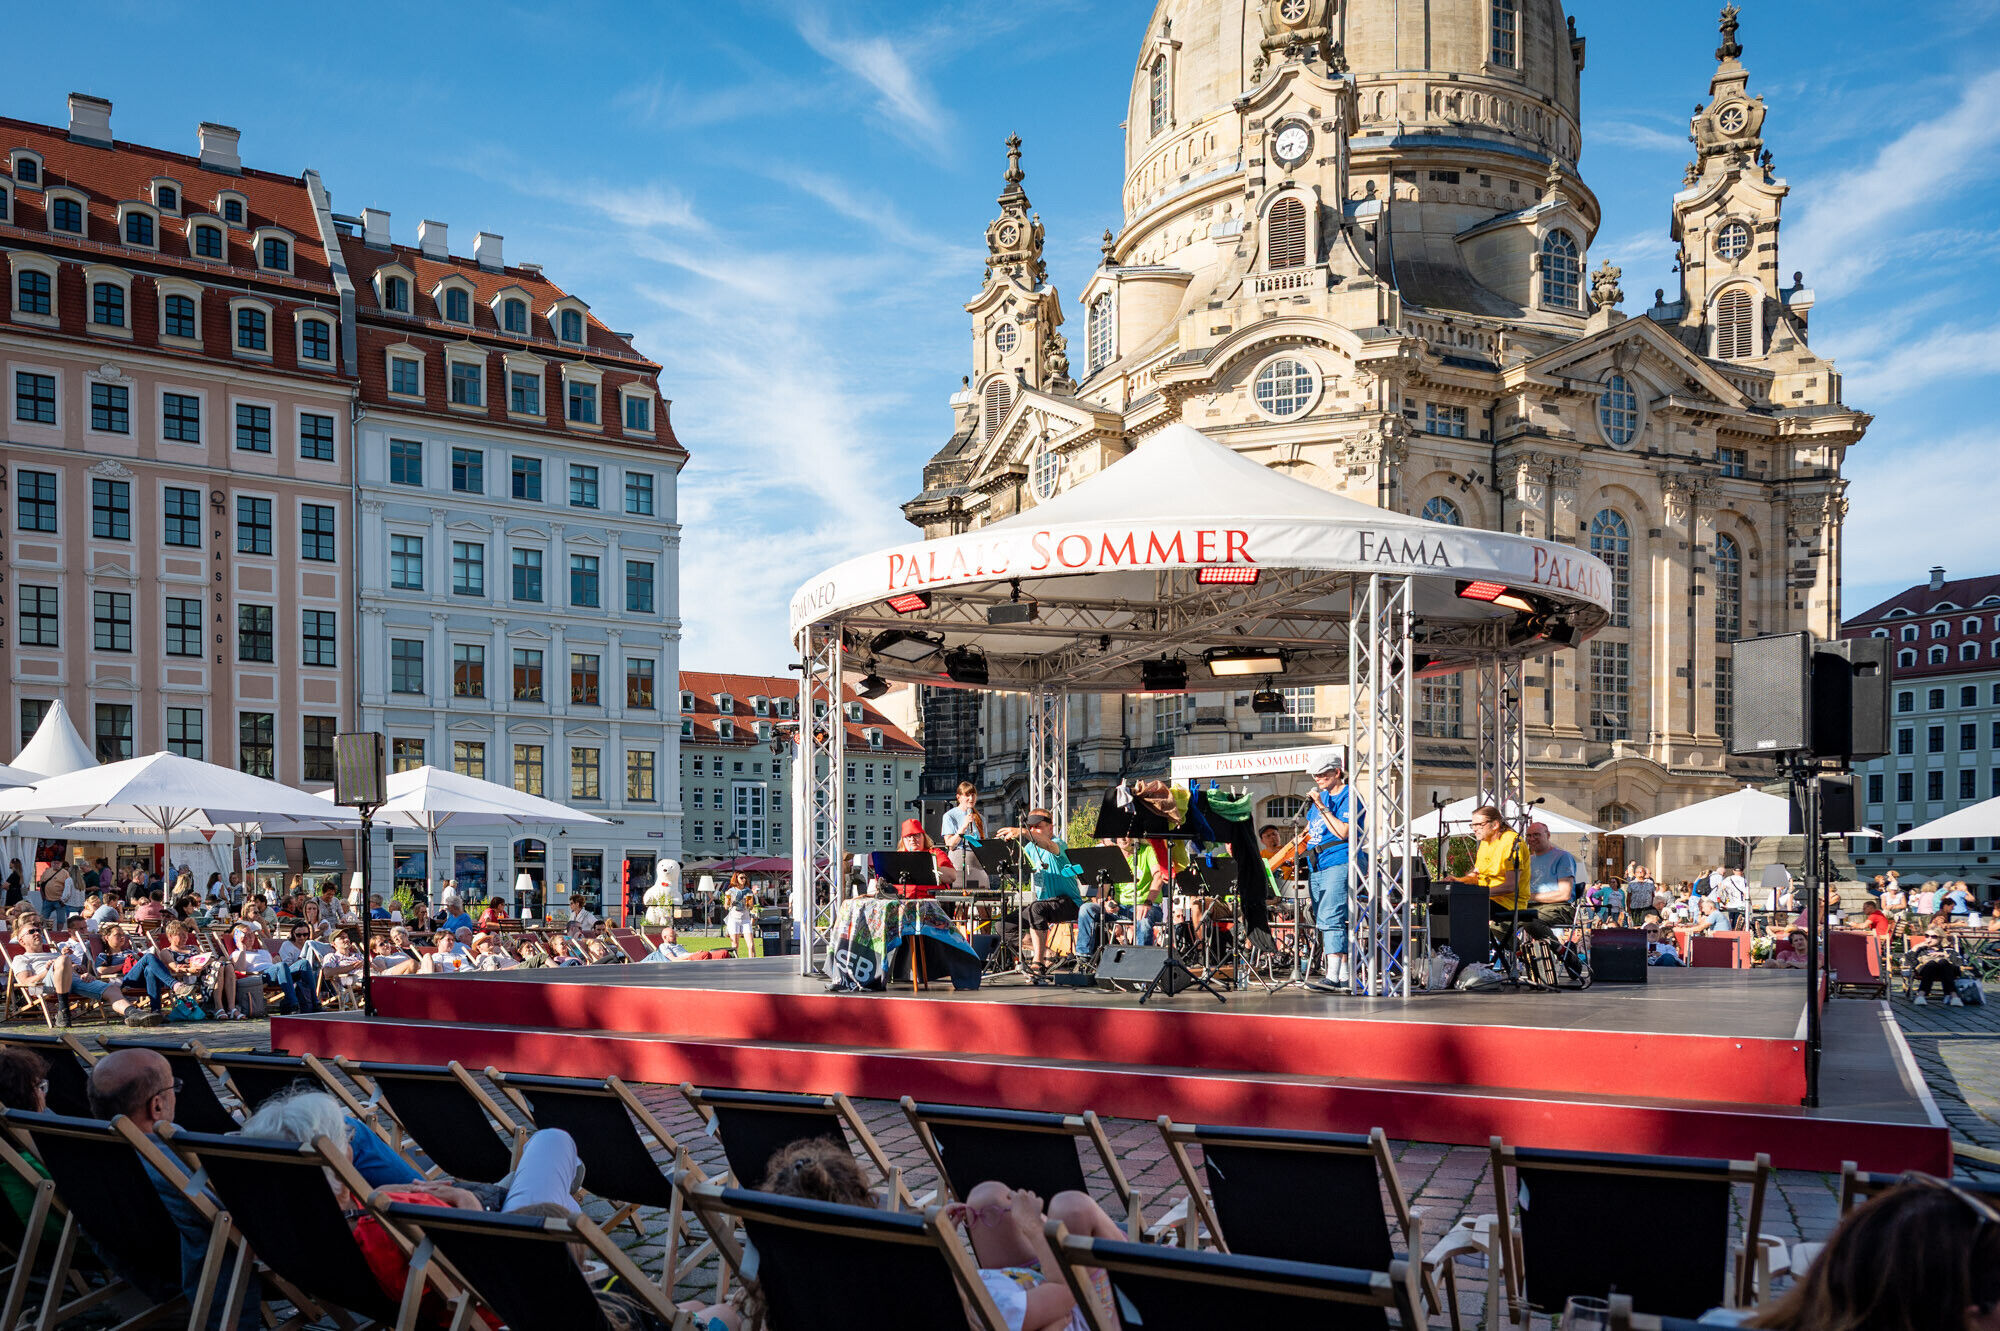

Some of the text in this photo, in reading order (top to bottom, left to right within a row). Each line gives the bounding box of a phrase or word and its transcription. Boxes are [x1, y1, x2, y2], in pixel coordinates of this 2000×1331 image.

[1030, 530, 1260, 571] SOMMER
[1357, 530, 1453, 568] FAMA
[1530, 545, 1601, 601] PALAIS
[214, 531, 223, 664] PASSAGE
[1216, 757, 1253, 771] PALAIS
[1256, 753, 1311, 768] SOMMER
